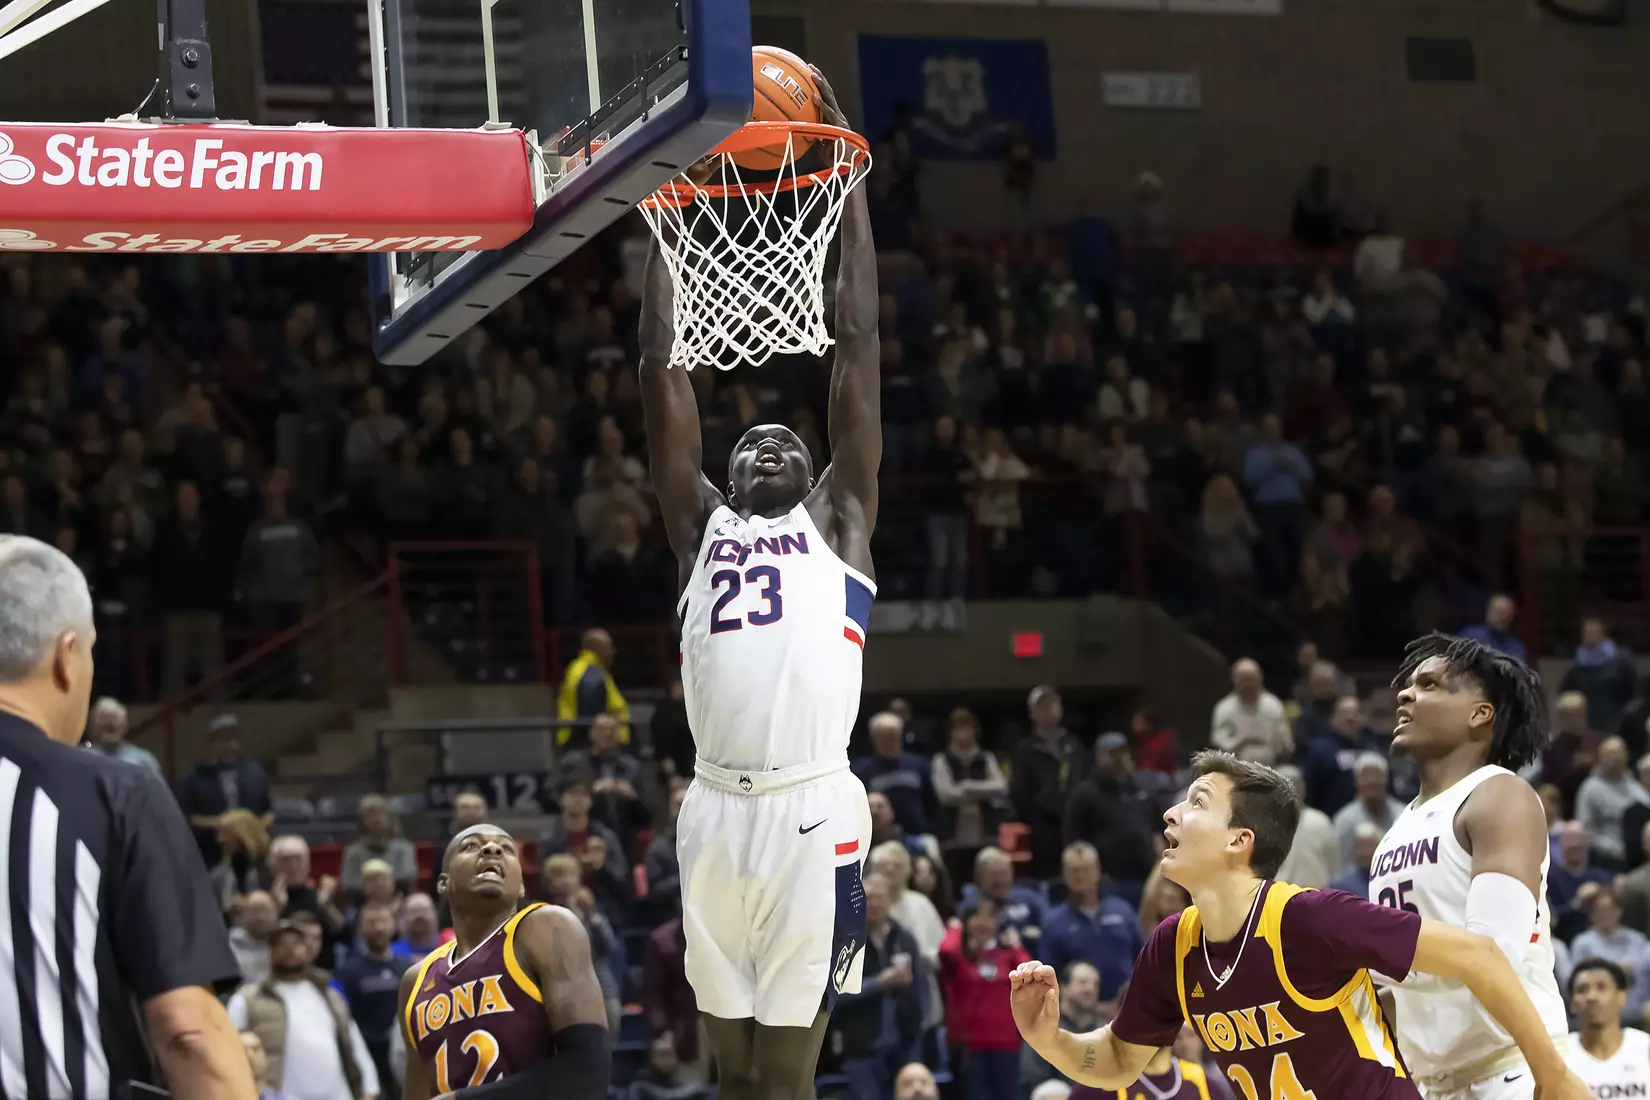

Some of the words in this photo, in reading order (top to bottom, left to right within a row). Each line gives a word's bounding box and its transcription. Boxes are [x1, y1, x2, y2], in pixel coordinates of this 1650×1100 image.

[42, 134, 185, 188] State
[189, 138, 324, 190] Farm
[67, 231, 281, 252] State
[286, 233, 483, 251] Farm
[709, 564, 783, 635] 23
[489, 774, 541, 809] 12
[1369, 836, 1440, 883] UCONN
[415, 974, 515, 1042] IONA
[1191, 1000, 1306, 1052] IONA
[435, 1028, 503, 1094] 12
[1589, 1082, 1646, 1099] ONN
